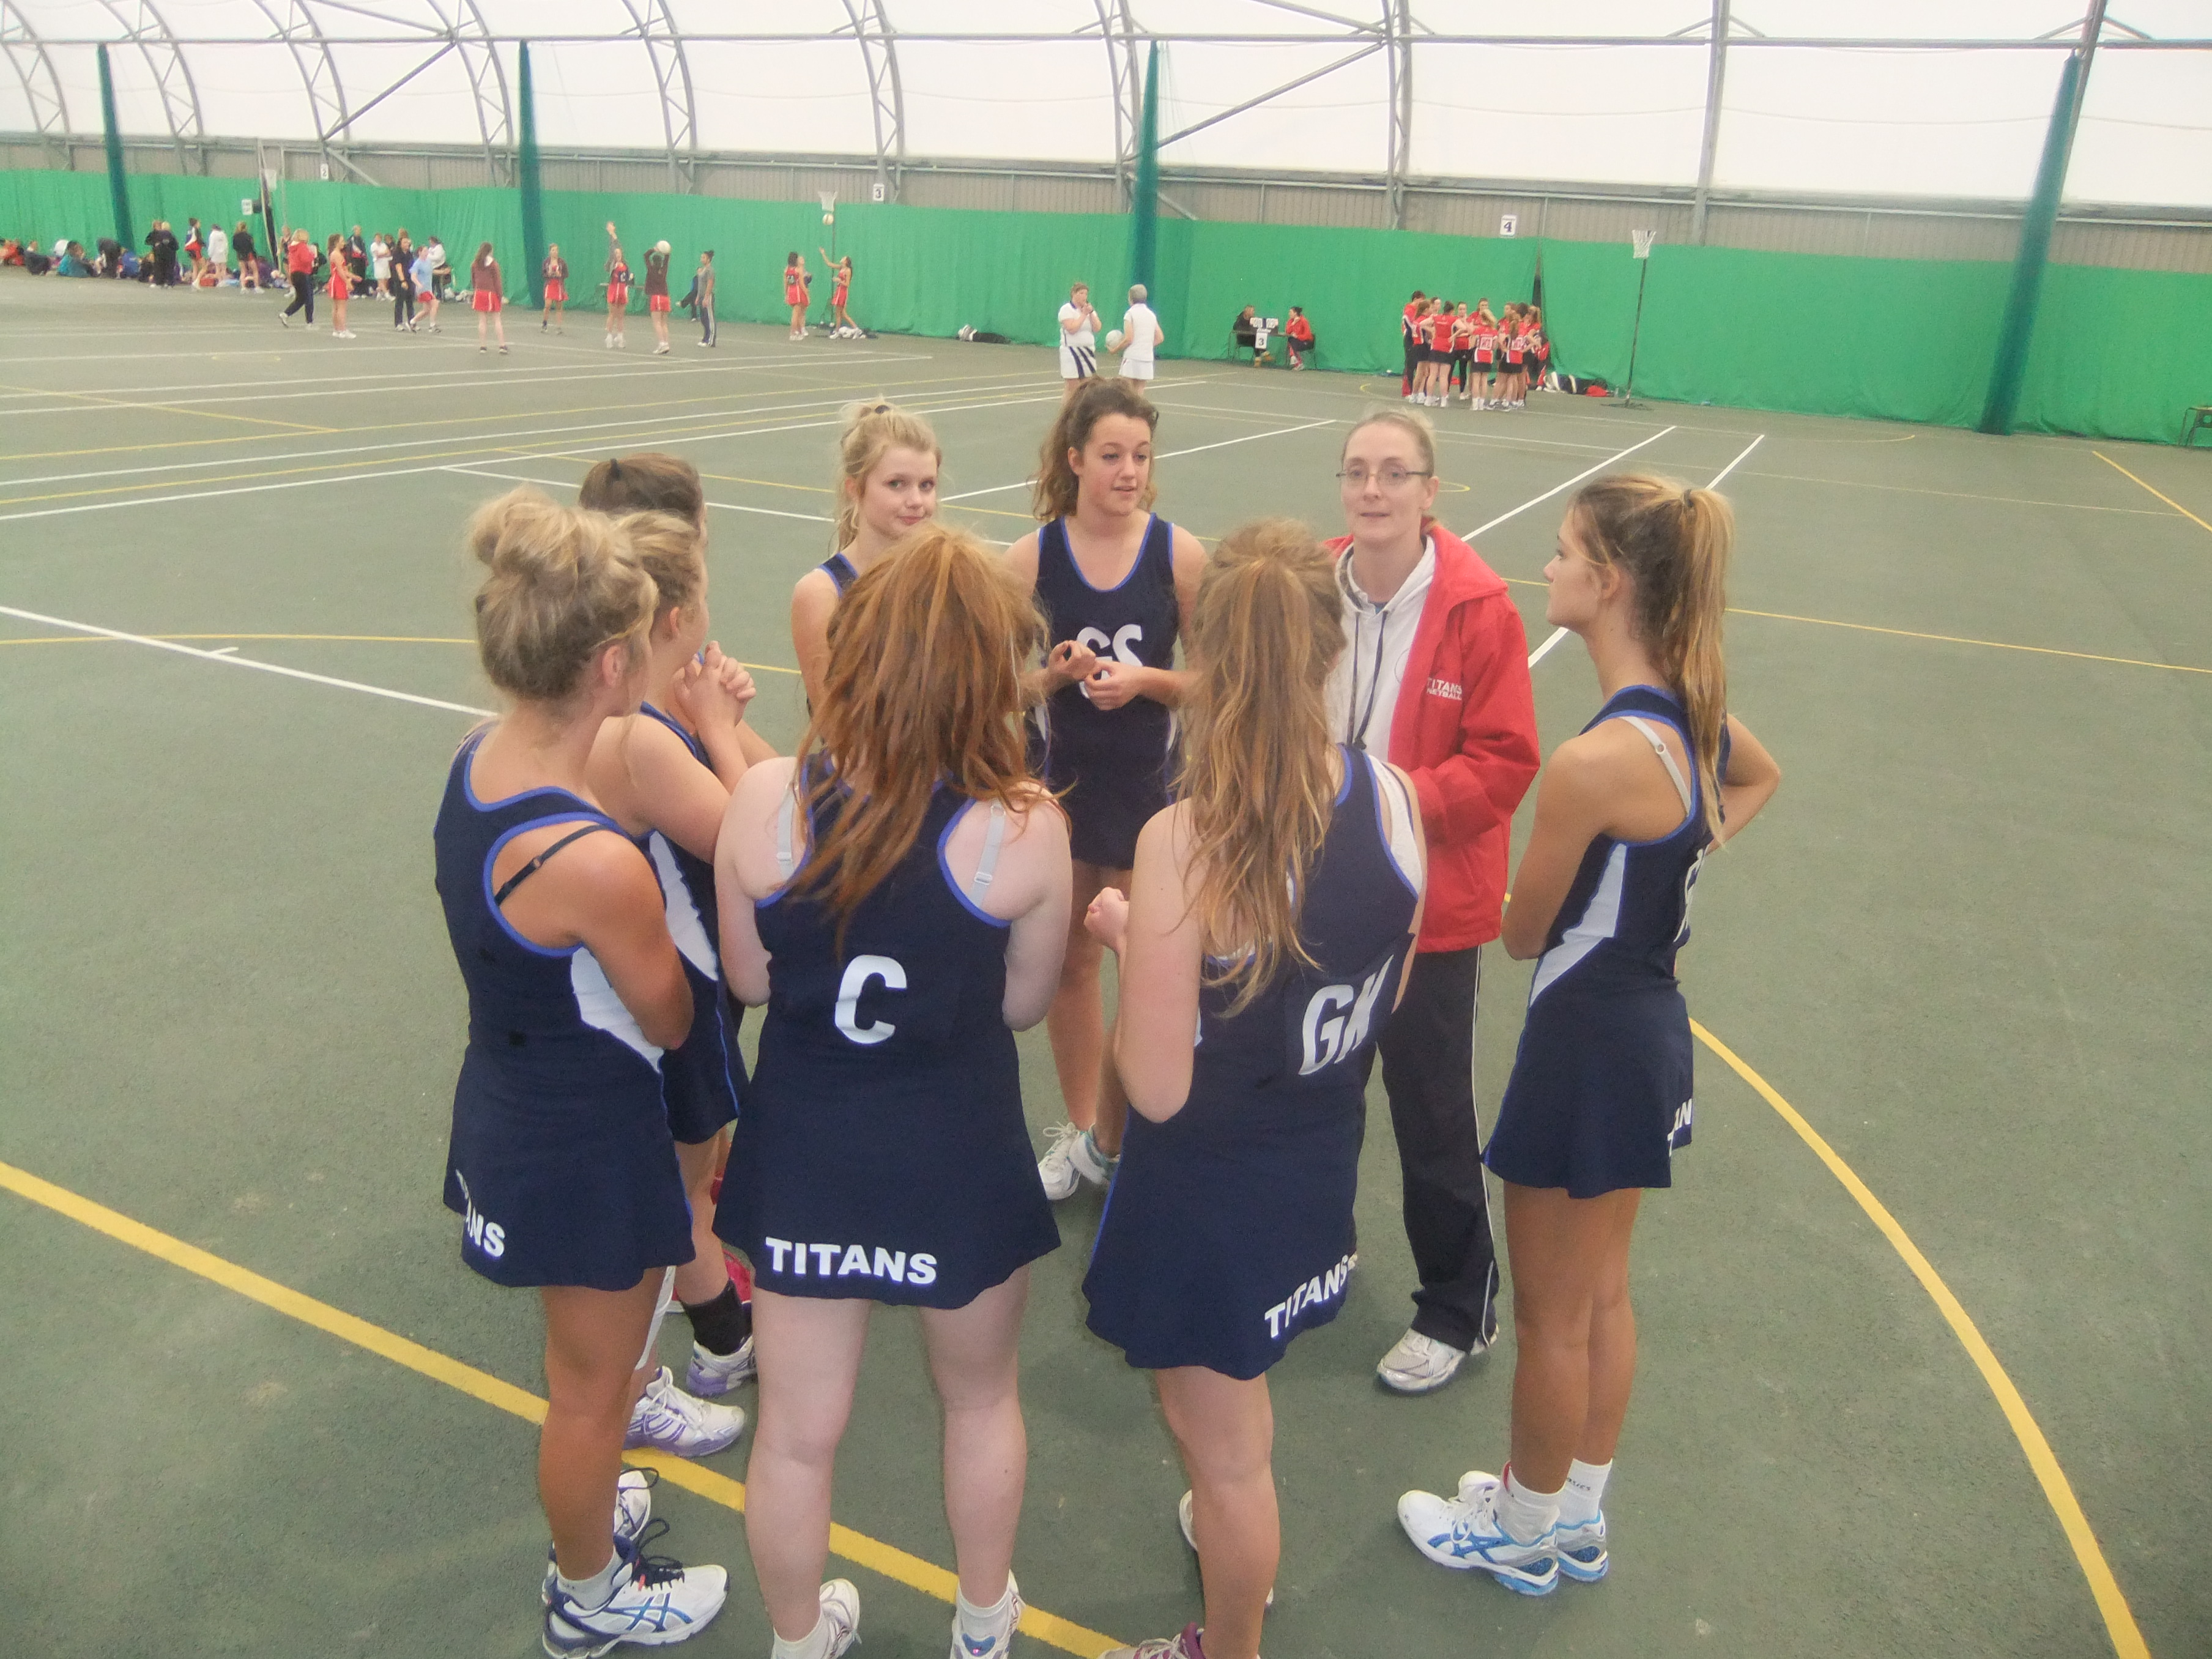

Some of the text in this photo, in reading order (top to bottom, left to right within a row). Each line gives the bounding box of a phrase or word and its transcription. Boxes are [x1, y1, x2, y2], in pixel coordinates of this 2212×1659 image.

[1504, 221, 1512, 232] 4
[1258, 338, 1264, 346] 3
[1427, 677, 1463, 695] TITANS
[834, 954, 907, 1044] C
[765, 1236, 938, 1284] TITANS
